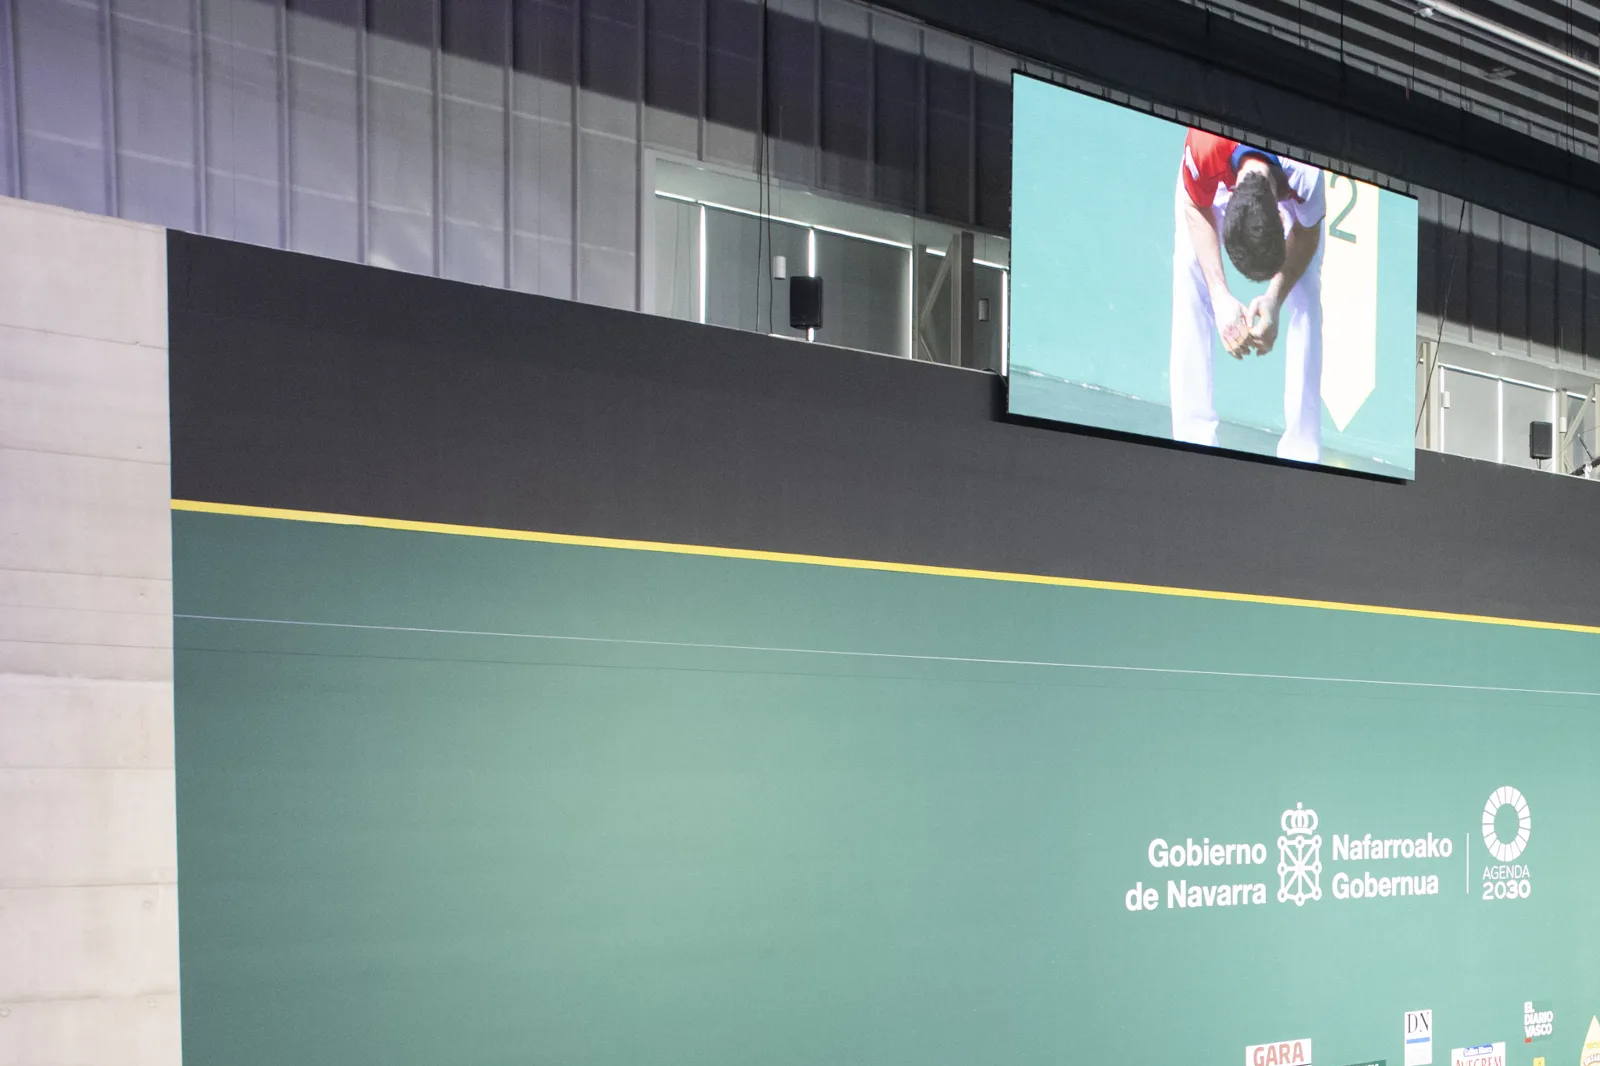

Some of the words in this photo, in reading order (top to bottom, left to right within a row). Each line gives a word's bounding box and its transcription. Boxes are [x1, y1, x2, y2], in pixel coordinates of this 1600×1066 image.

[1328, 172, 1357, 244] 2
[1148, 838, 1267, 868] Gobierno
[1332, 832, 1452, 861] Nafarroako
[1482, 864, 1530, 880] AGENDA
[1126, 882, 1158, 911] de
[1167, 879, 1266, 908] Navarra
[1332, 872, 1438, 900] Gobernua
[1482, 879, 1531, 900] 2030
[1524, 1001, 1535, 1014] EL
[1524, 1010, 1554, 1026] DIARIO
[1407, 1012, 1430, 1034] DN
[1524, 1022, 1552, 1038] VASCO
